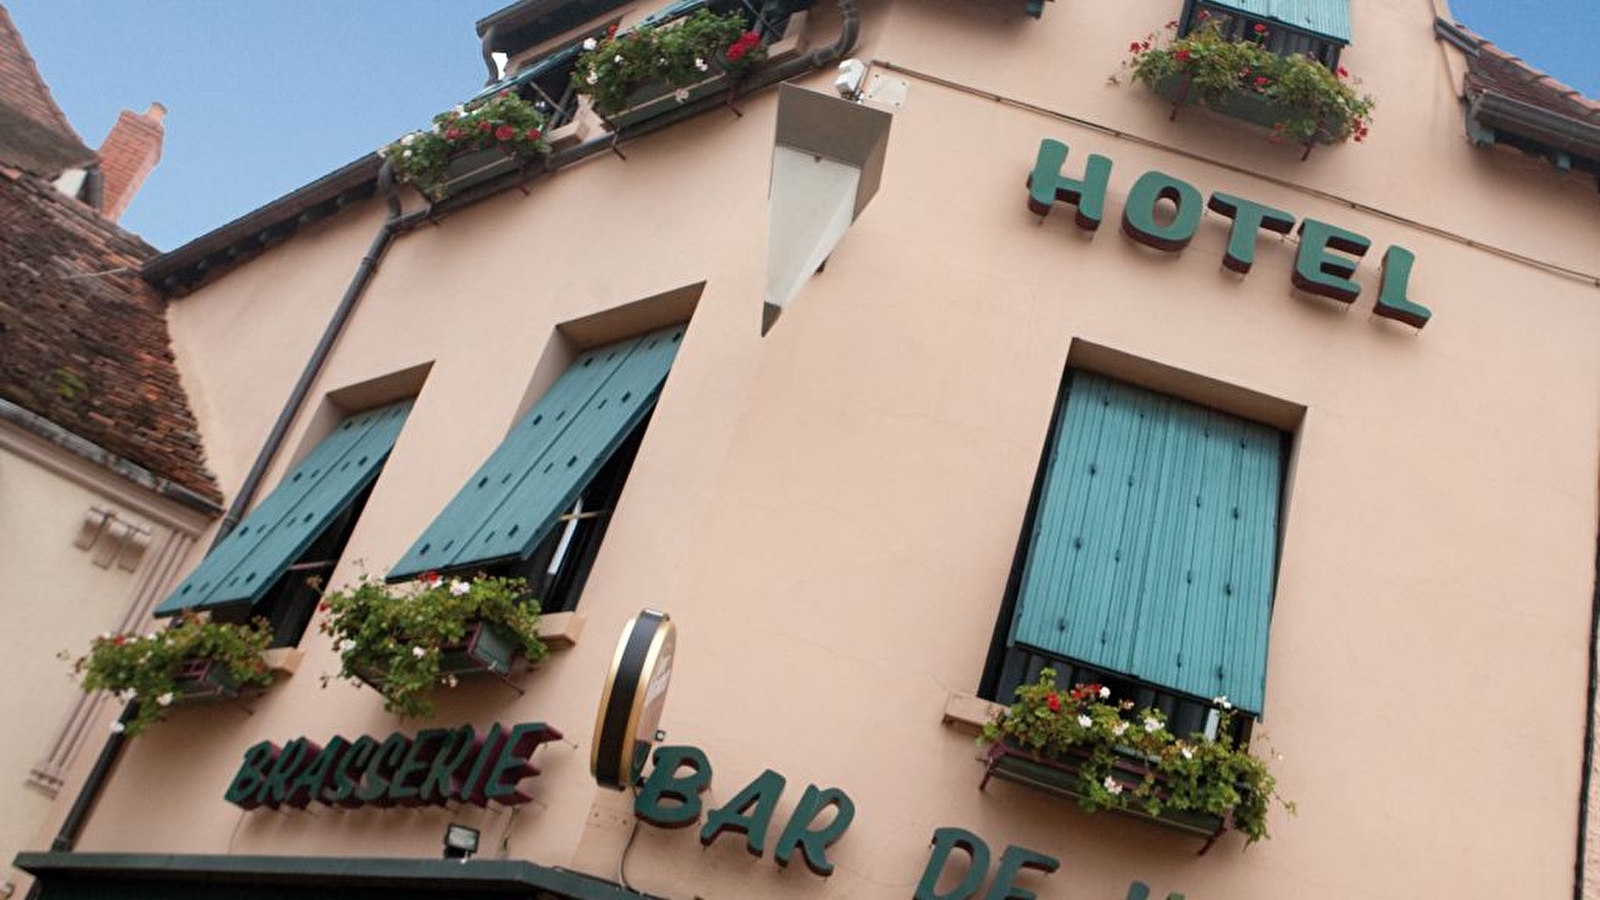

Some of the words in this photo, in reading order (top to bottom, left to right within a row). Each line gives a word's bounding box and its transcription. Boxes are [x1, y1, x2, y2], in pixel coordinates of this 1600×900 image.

[1027, 138, 1432, 330] HOTEL
[224, 722, 563, 810] BRASSERIE
[634, 745, 855, 876] BAR
